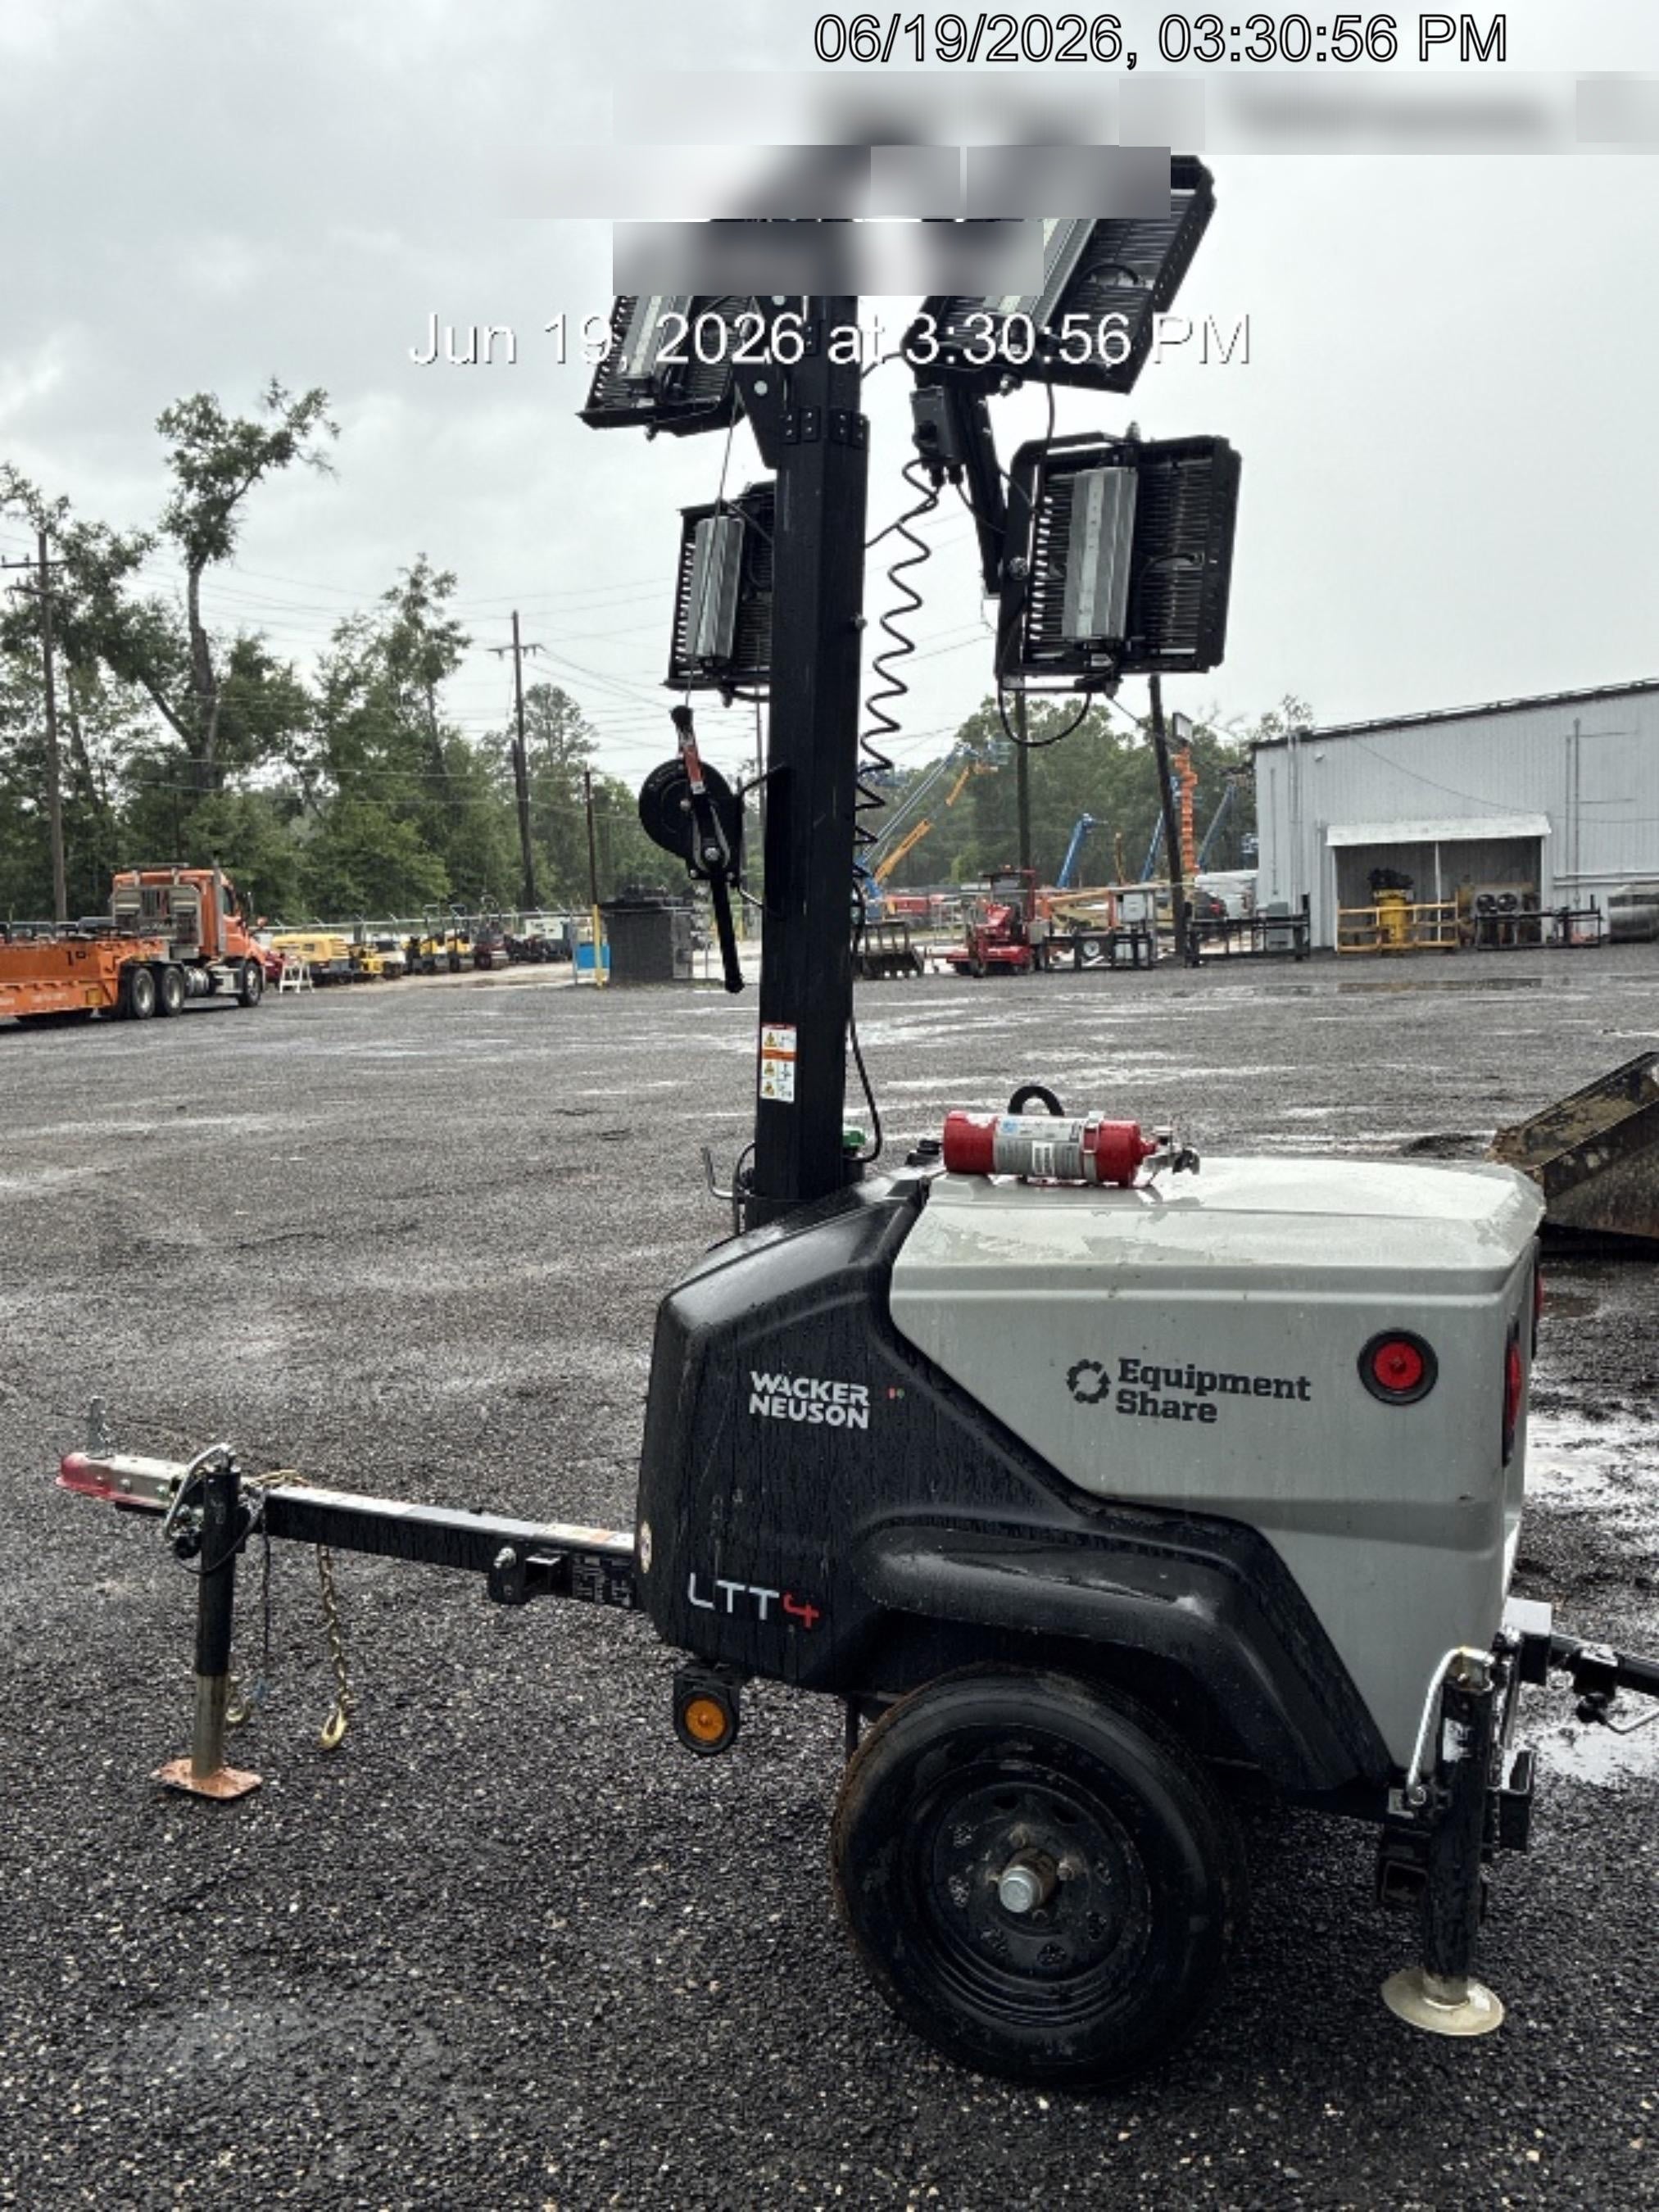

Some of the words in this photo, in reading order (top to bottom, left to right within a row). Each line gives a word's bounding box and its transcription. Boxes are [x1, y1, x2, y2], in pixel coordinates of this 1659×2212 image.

[750, 1371, 870, 1406] WACKER
[1117, 1357, 1312, 1401] Equipment
[749, 1393, 869, 1429] NEUSON
[1116, 1389, 1217, 1423] Share
[687, 1572, 820, 1628] LTT4
